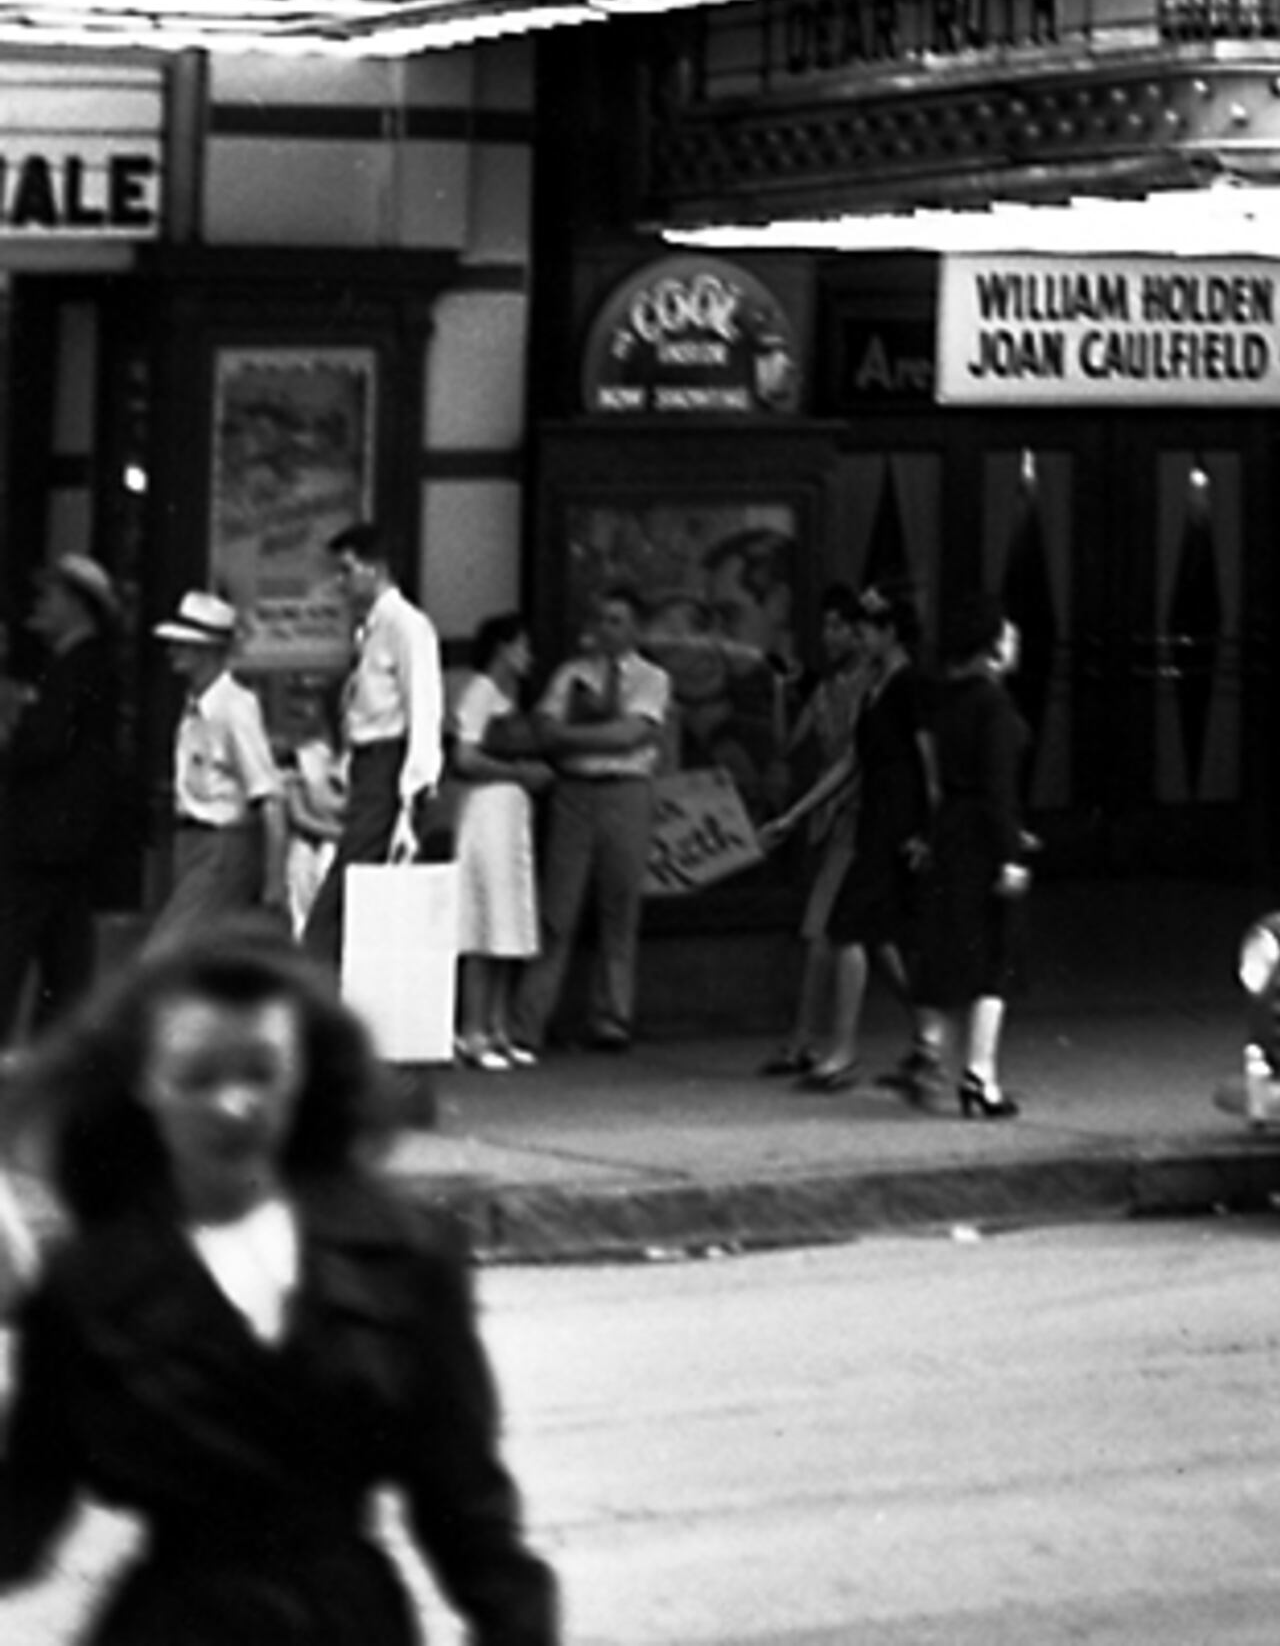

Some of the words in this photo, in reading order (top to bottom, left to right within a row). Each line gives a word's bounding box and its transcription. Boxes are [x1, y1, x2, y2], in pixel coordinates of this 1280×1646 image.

[0, 155, 155, 227] ALE
[975, 272, 1130, 323] WILLIAM
[1140, 274, 1275, 325] HOLDEN
[967, 331, 1065, 380] JOAN
[1078, 331, 1270, 381] CAULFIELD
